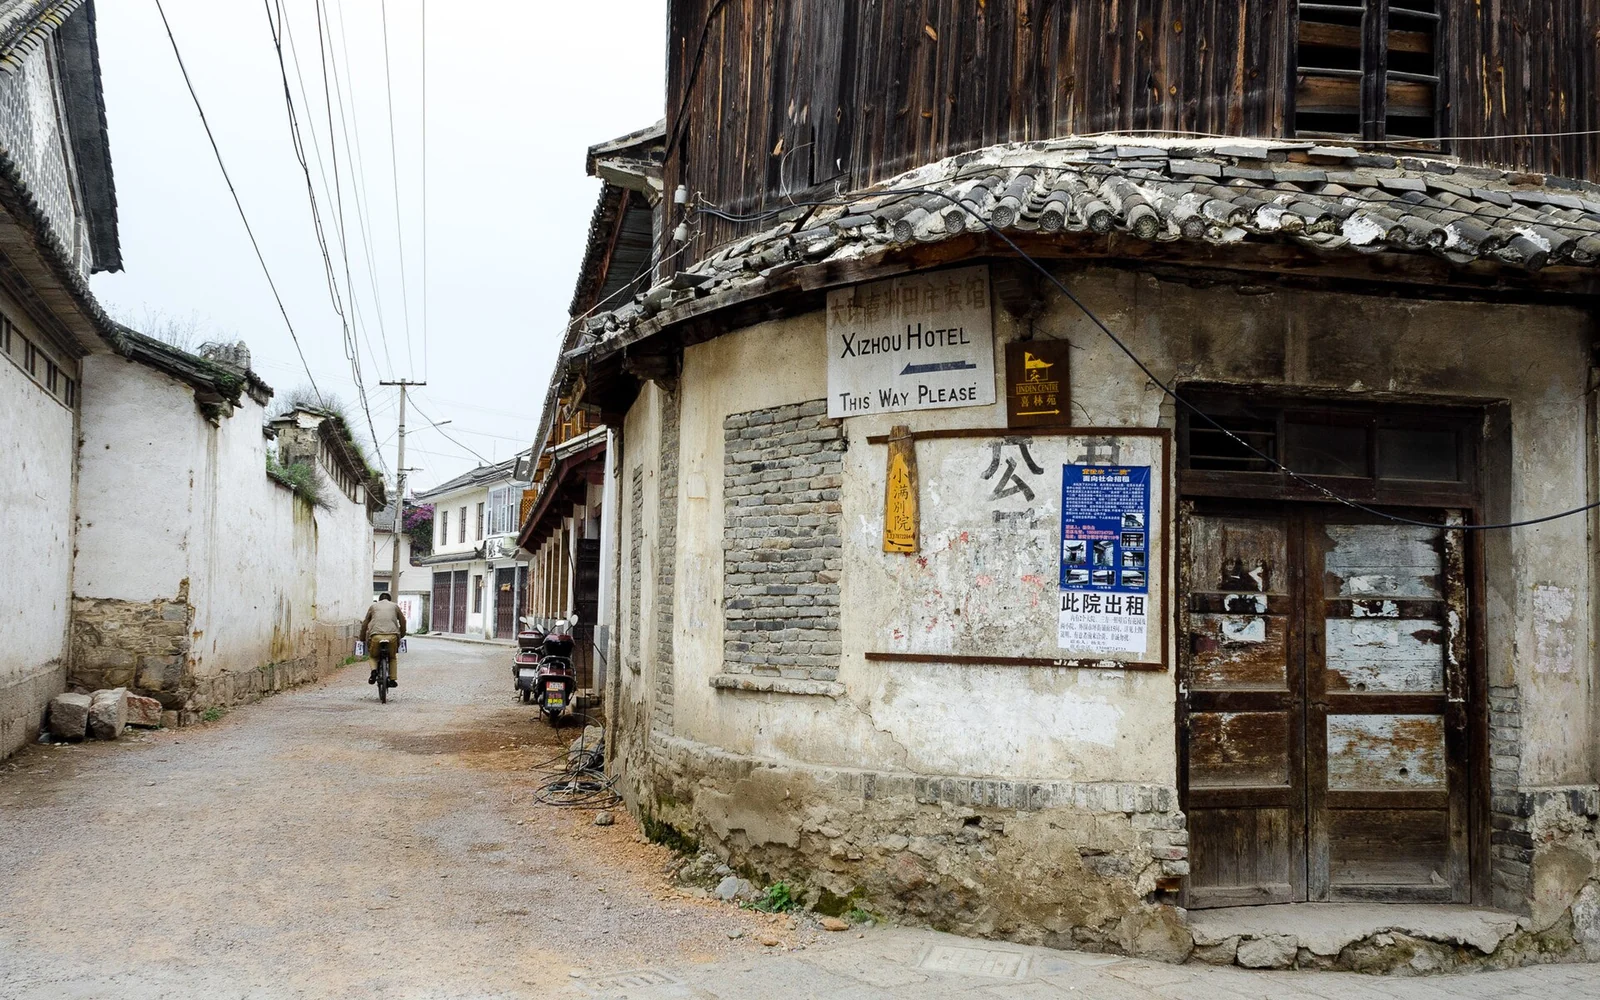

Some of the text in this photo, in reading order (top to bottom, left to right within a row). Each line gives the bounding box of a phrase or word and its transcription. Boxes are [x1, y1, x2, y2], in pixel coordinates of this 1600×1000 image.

[1038, 383, 1059, 393] CENTRE
[1020, 394, 1057, 408] 喜林苑
[1082, 475, 1130, 483] 面向社会招租
[1061, 593, 1145, 616] 此院出租
